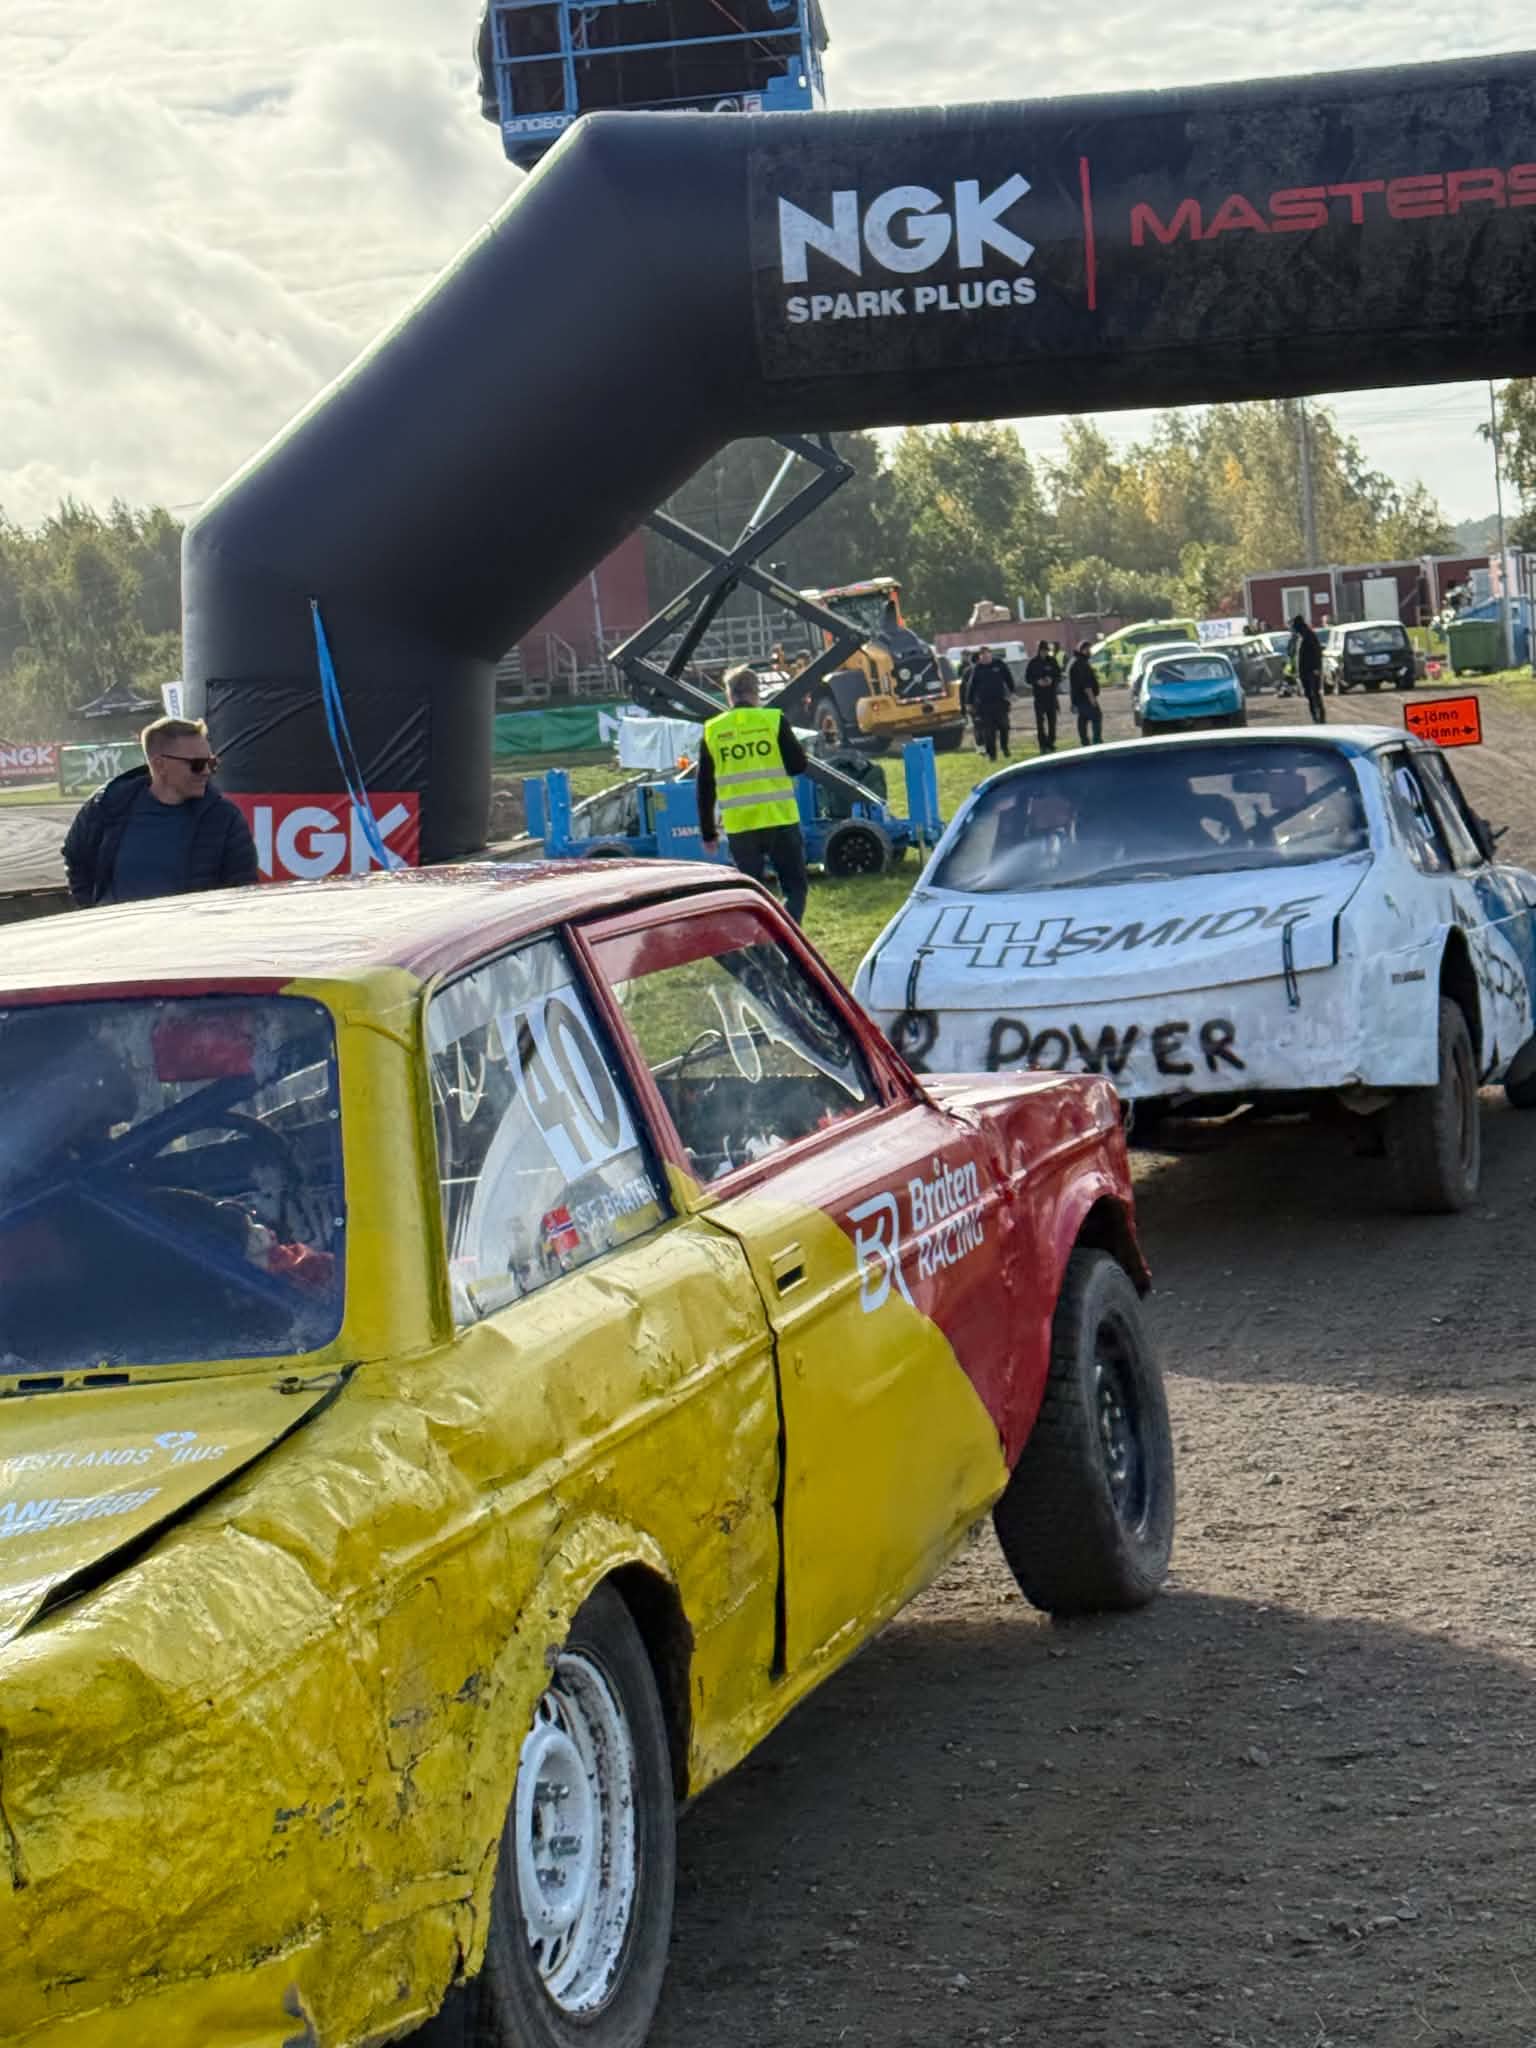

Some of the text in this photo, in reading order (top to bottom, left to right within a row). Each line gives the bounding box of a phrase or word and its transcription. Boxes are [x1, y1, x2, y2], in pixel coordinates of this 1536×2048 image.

[778, 173, 1036, 283] NGK
[786, 277, 1037, 323] SPARK PLUGS
[0, 746, 55, 768] NGK
[720, 740, 772, 761] FOTO
[1044, 895, 1326, 957] SMIDE
[985, 1016, 1246, 1075] POWER
[514, 997, 621, 1166] 40
[908, 1157, 980, 1231] Bråten
[916, 1201, 985, 1281] RACING
[171, 1445, 228, 1463] HUS
